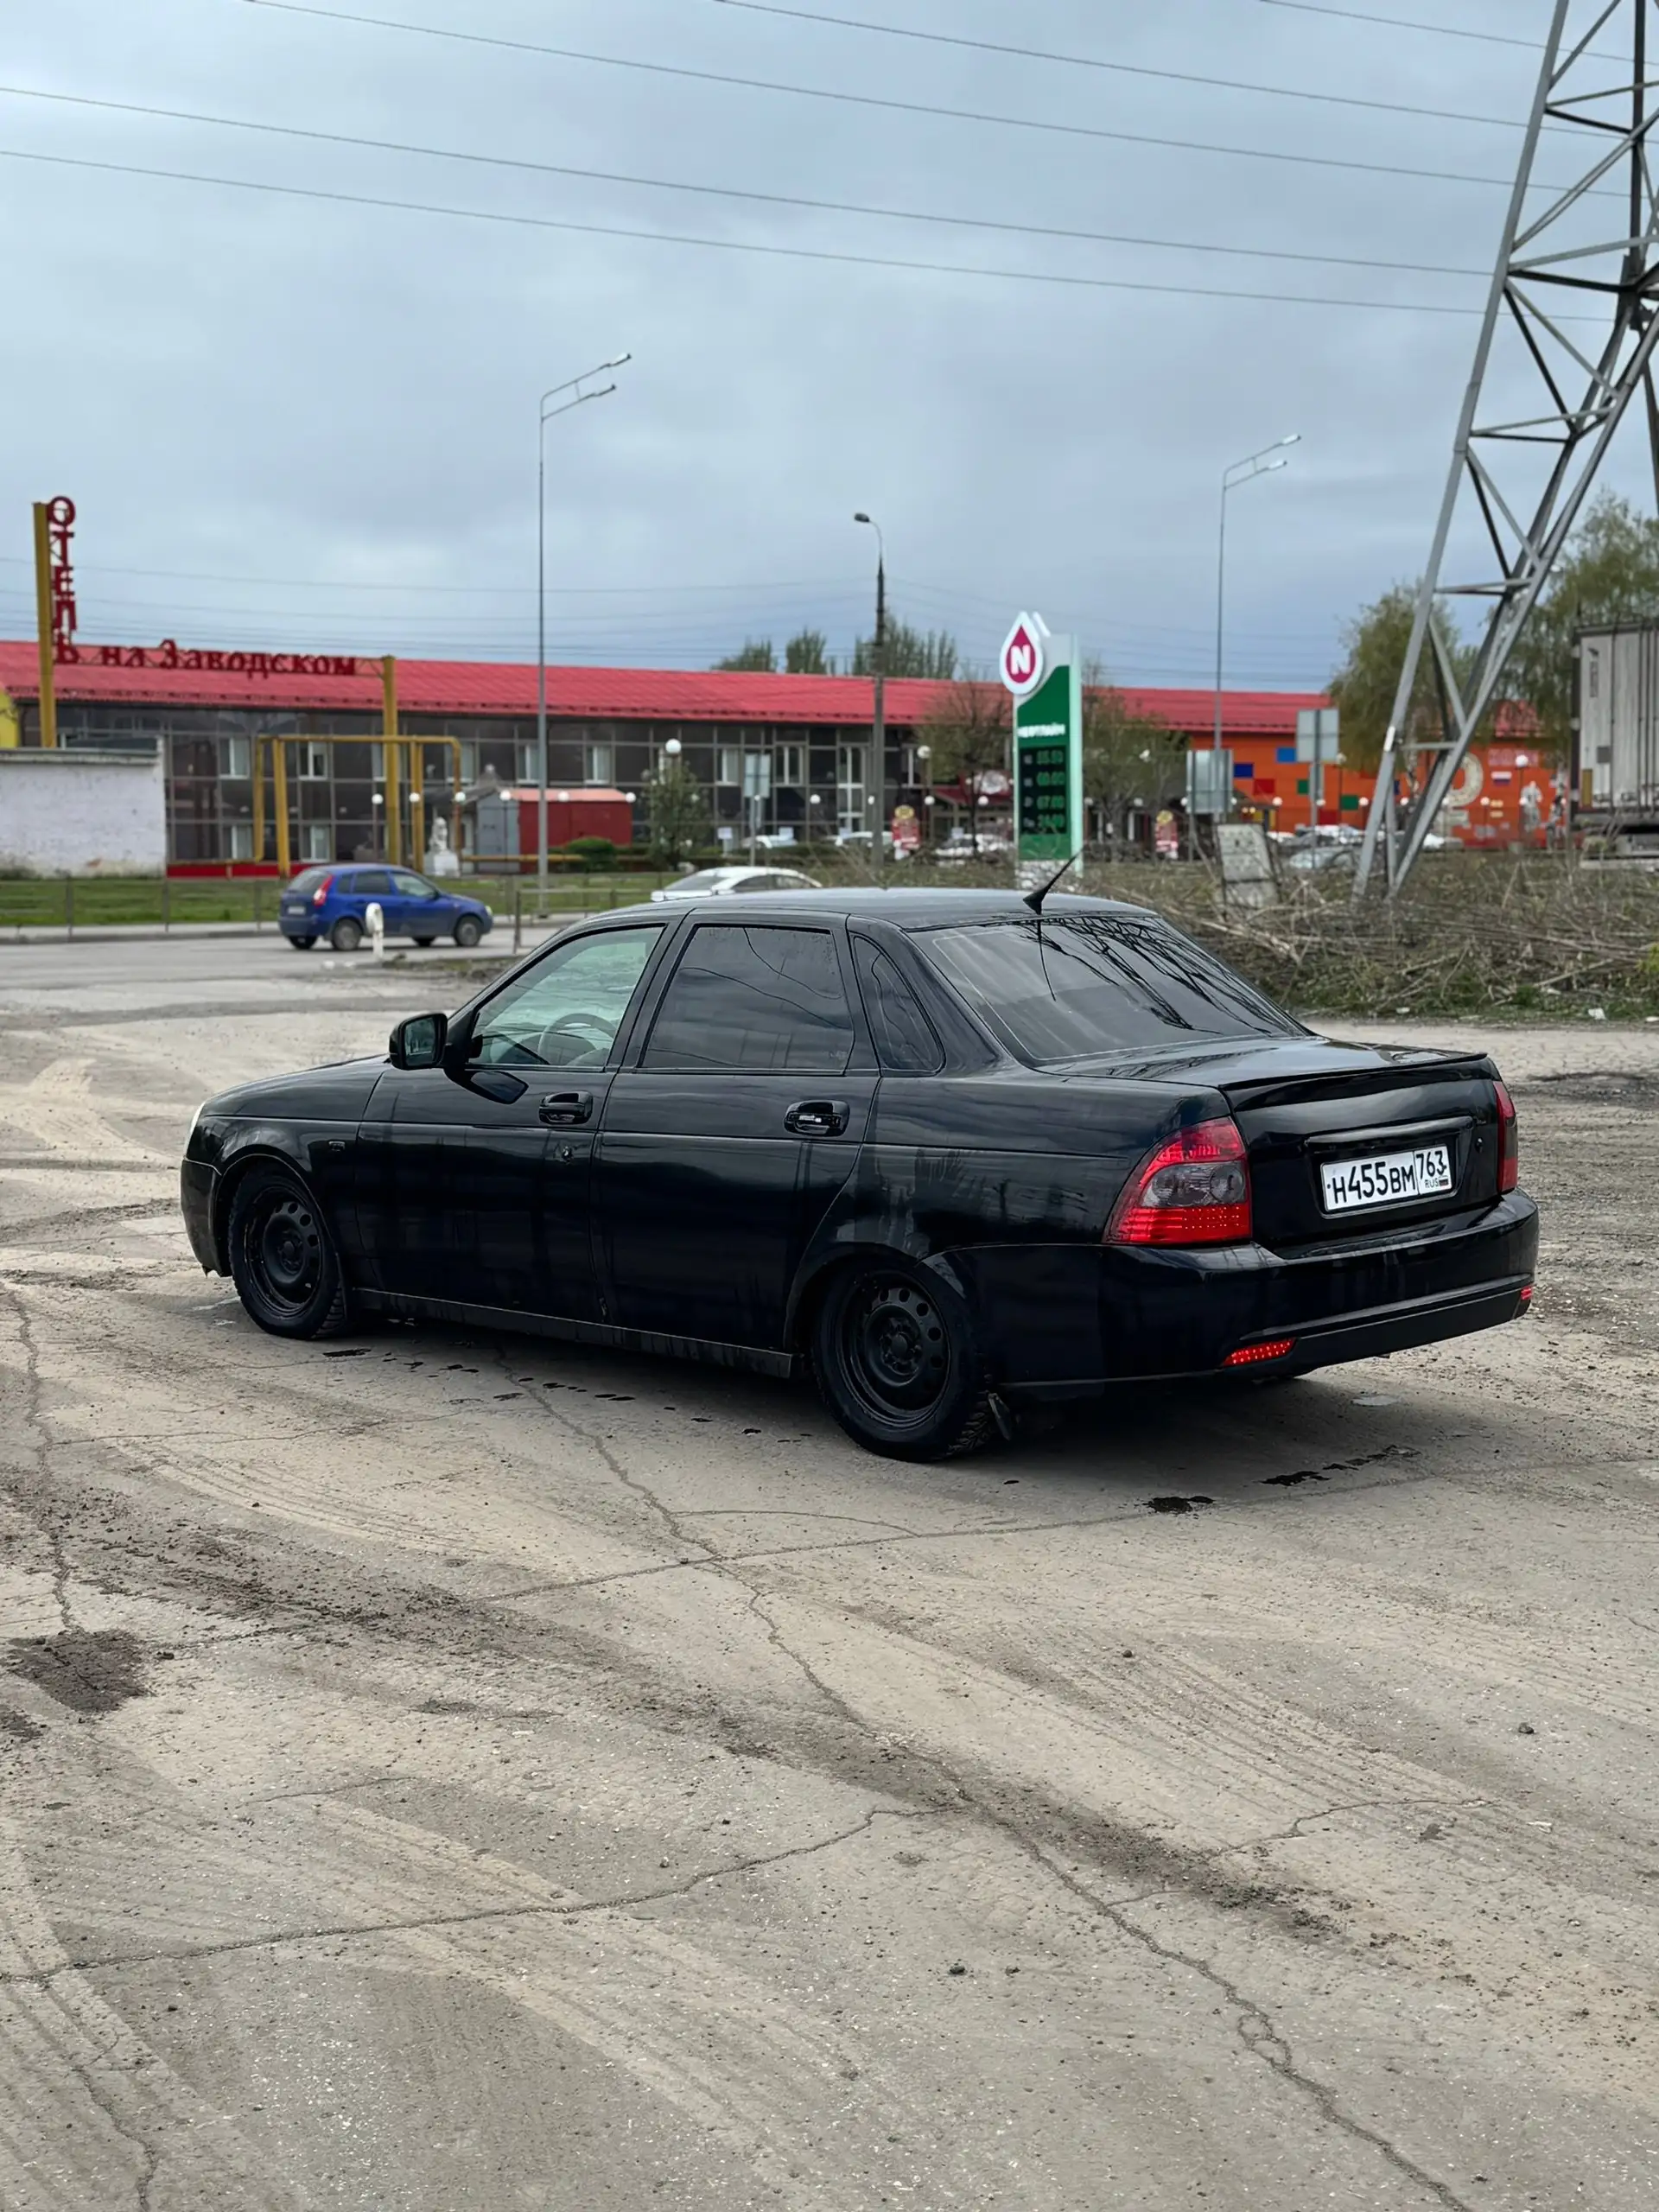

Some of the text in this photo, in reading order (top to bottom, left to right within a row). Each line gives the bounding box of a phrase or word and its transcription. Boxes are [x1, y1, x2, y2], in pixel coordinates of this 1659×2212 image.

[48, 496, 79, 664] ОТЕЛЬ
[100, 639, 356, 679] на Заводском
[1010, 644, 1031, 675] N
[1415, 1150, 1446, 1180] 763
[1424, 1178, 1439, 1189] RUS
